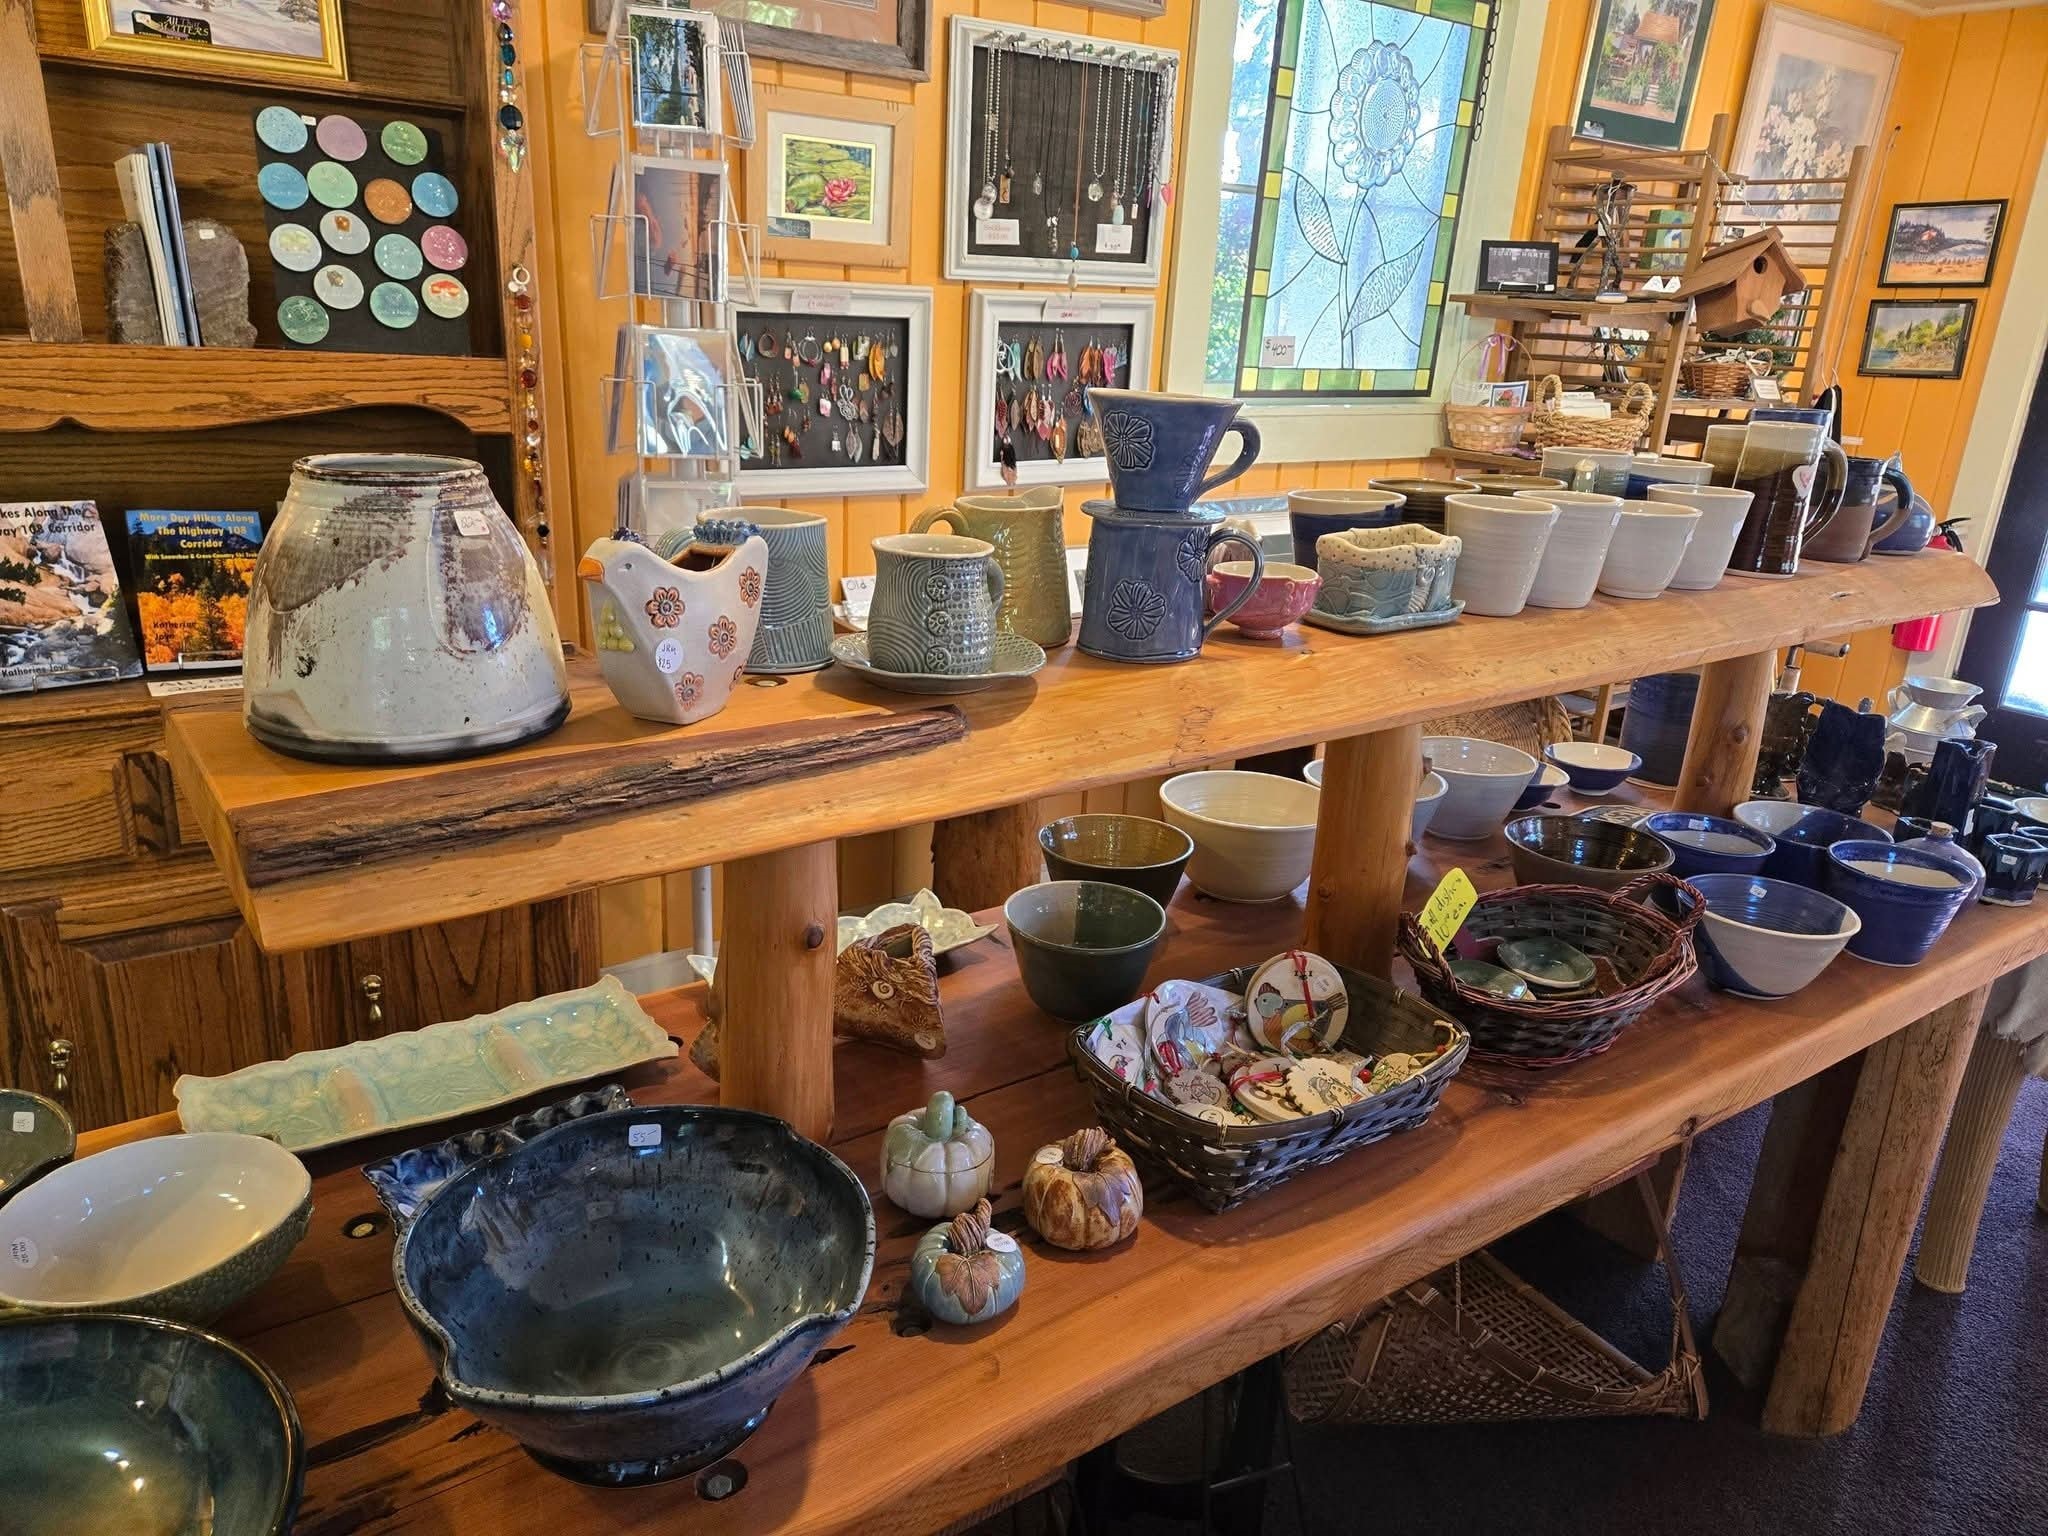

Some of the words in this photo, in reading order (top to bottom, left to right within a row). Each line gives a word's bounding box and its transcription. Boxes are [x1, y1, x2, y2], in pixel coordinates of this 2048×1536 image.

[24, 506, 58, 520] Along
[61, 505, 82, 517] The
[140, 512, 167, 522] More
[170, 513, 190, 523] Day
[193, 513, 222, 523] Hikes
[225, 513, 254, 524] Along
[21, 523, 44, 535] 108
[48, 521, 96, 534] Corridor
[157, 526, 176, 536] The
[179, 526, 224, 537] Highway
[228, 526, 247, 535] 108
[180, 539, 223, 549] Corridor
